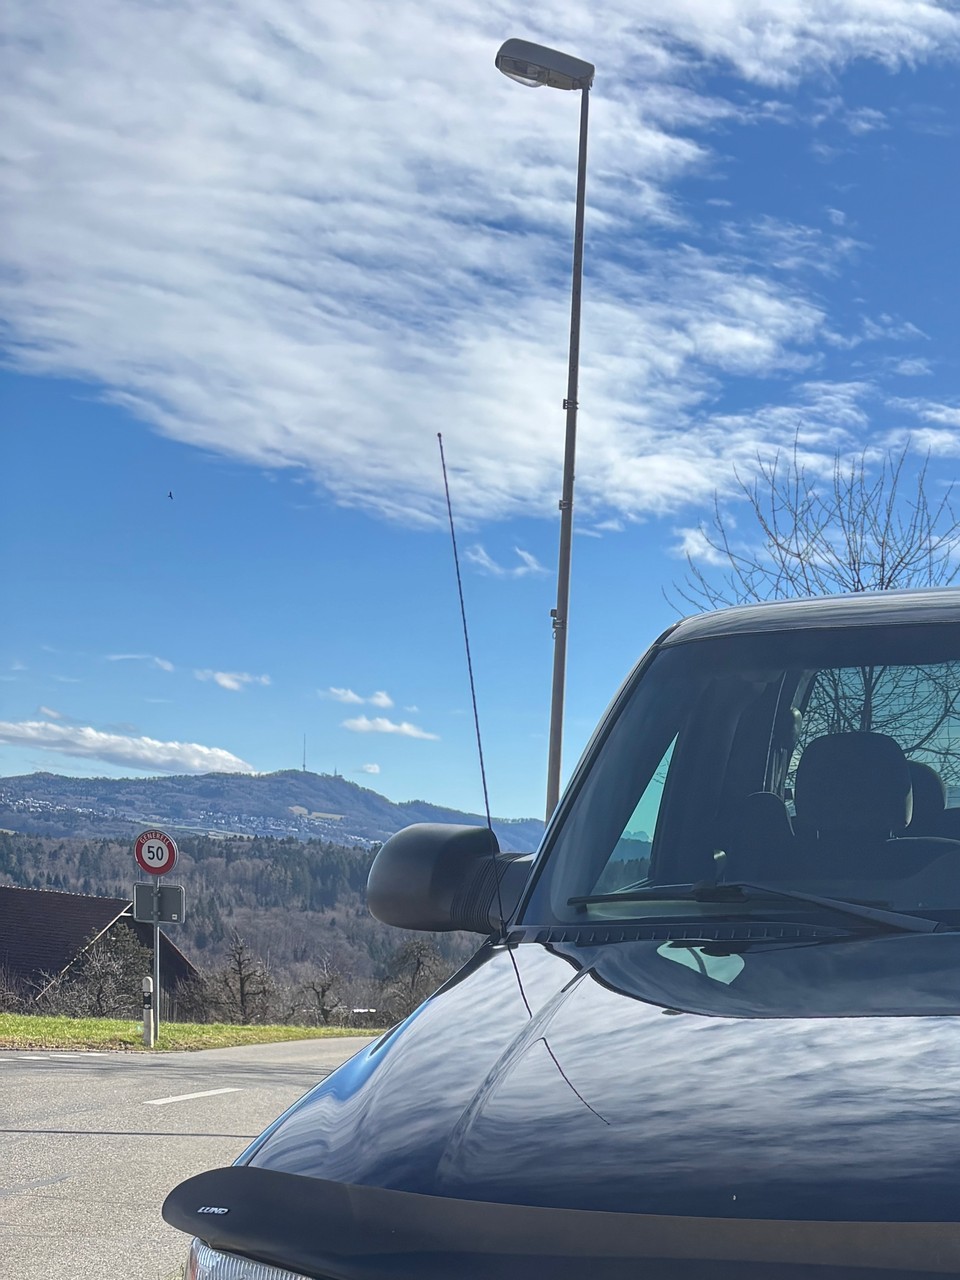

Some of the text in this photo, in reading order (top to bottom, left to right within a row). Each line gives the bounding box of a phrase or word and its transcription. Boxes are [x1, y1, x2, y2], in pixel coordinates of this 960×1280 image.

[139, 832, 170, 845] GENERELL
[147, 845, 164, 861] 50
[197, 1206, 229, 1214] LUND
